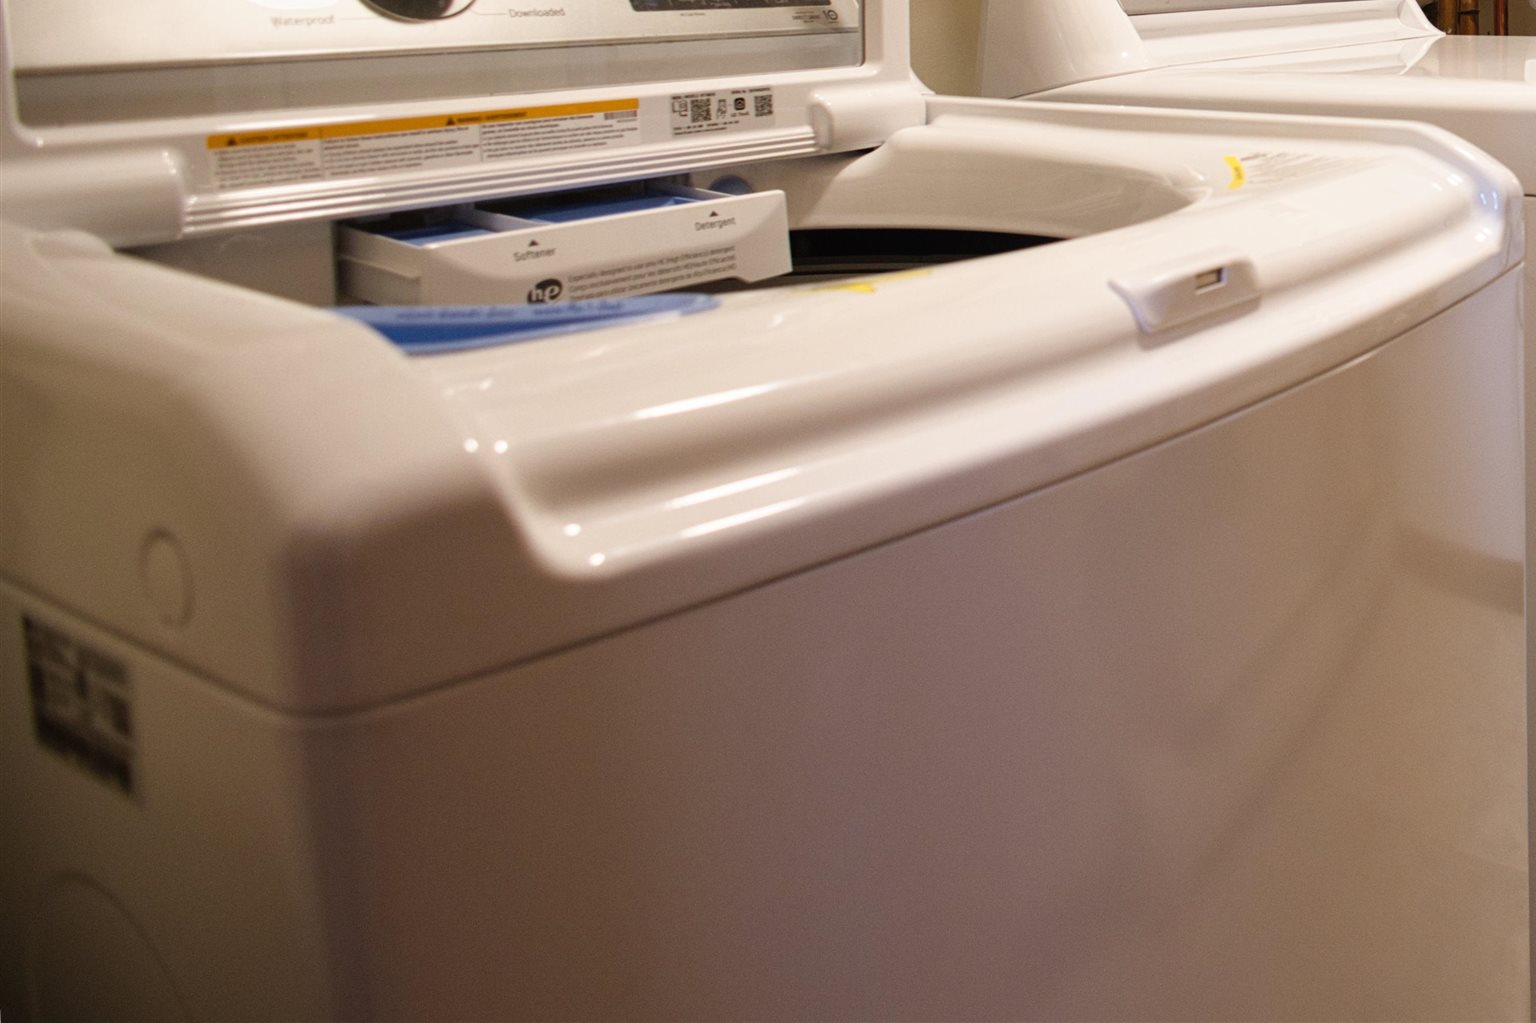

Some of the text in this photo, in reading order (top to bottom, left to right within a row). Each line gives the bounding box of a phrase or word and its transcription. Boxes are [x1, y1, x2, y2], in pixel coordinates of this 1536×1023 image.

[508, 7, 566, 18] Downloaded
[271, 14, 336, 28] Waterproof
[694, 216, 736, 232] Detergent
[513, 246, 557, 263] Softener
